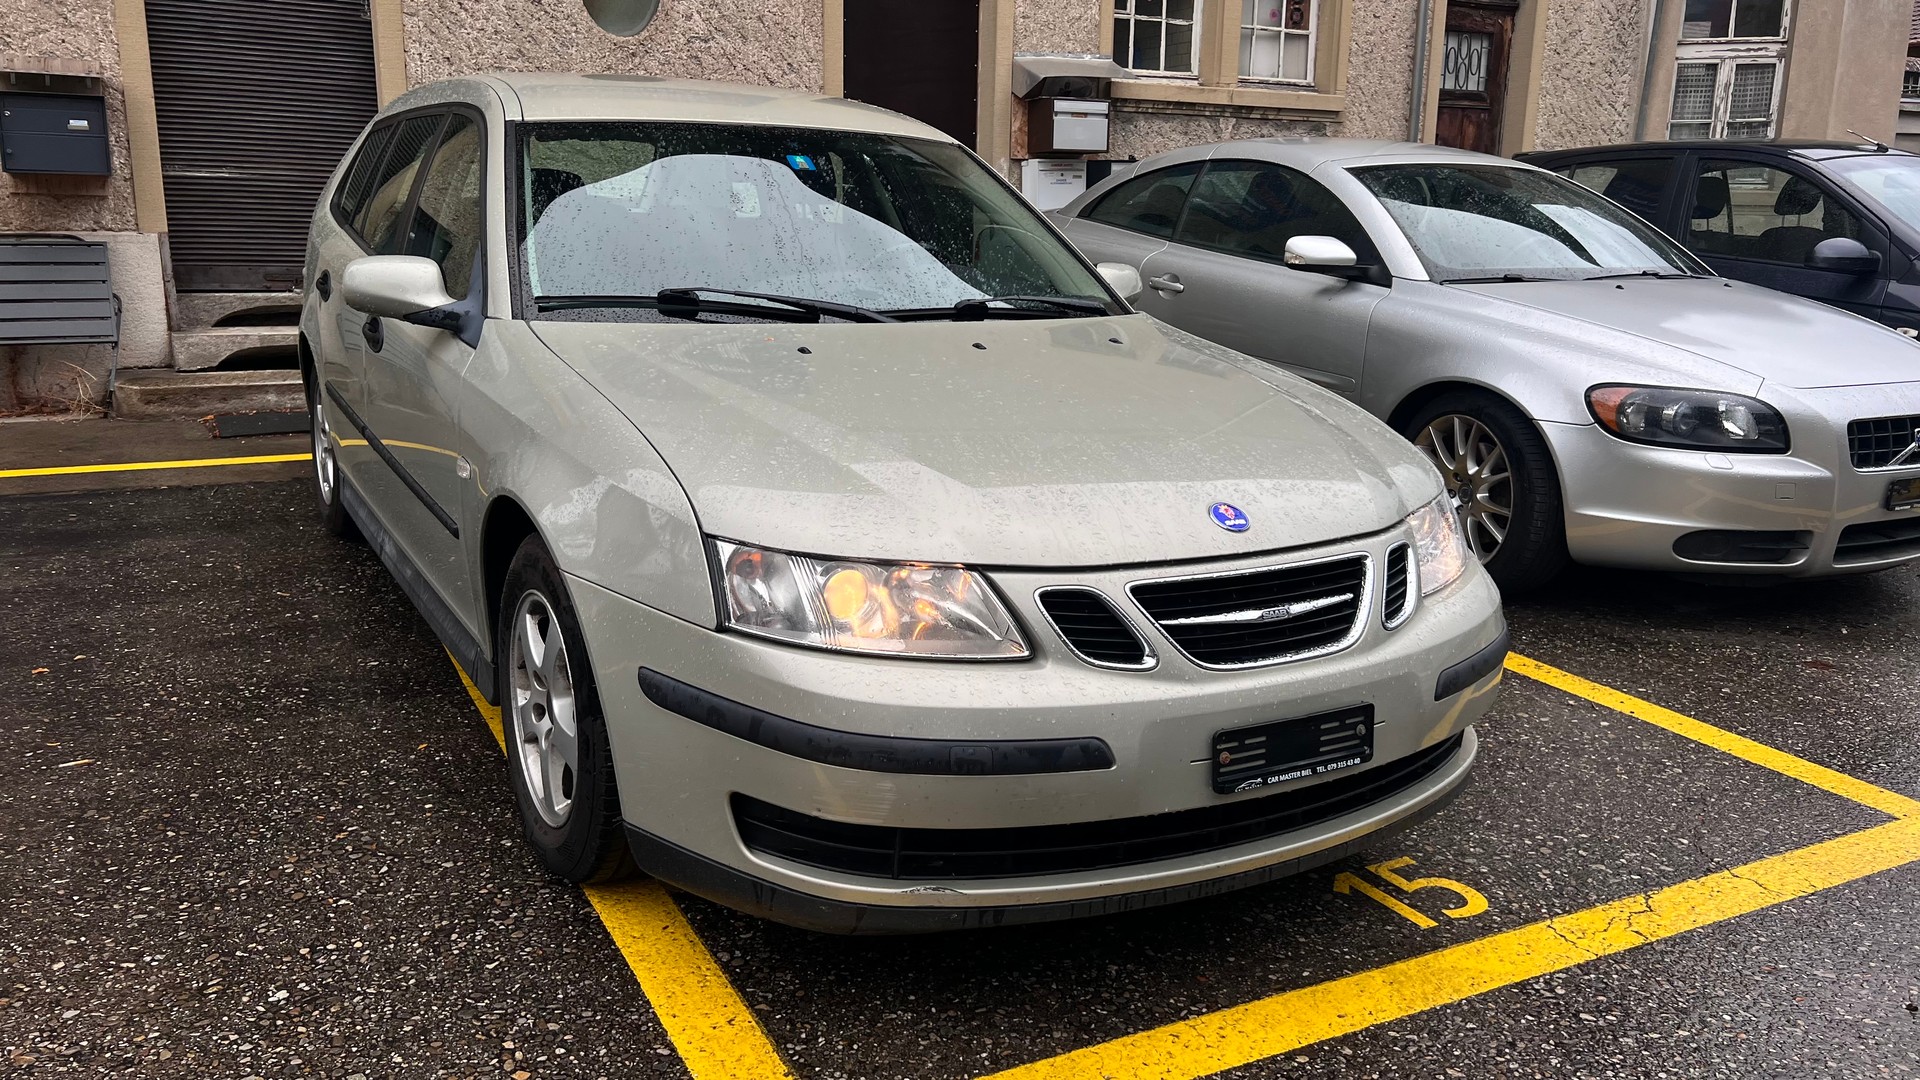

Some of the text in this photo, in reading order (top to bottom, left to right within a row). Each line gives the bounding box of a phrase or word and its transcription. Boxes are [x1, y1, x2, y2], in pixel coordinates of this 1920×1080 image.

[1262, 609, 1287, 619] SAAB
[1267, 775, 1279, 784] CAR
[1279, 771, 1301, 782] MASTER
[1301, 768, 1313, 777] BIEL
[1327, 762, 1337, 771] 079
[1337, 760, 1347, 769] 315
[1347, 758, 1354, 766] 43
[1354, 757, 1361, 765] 40
[1333, 856, 1489, 929] 15
